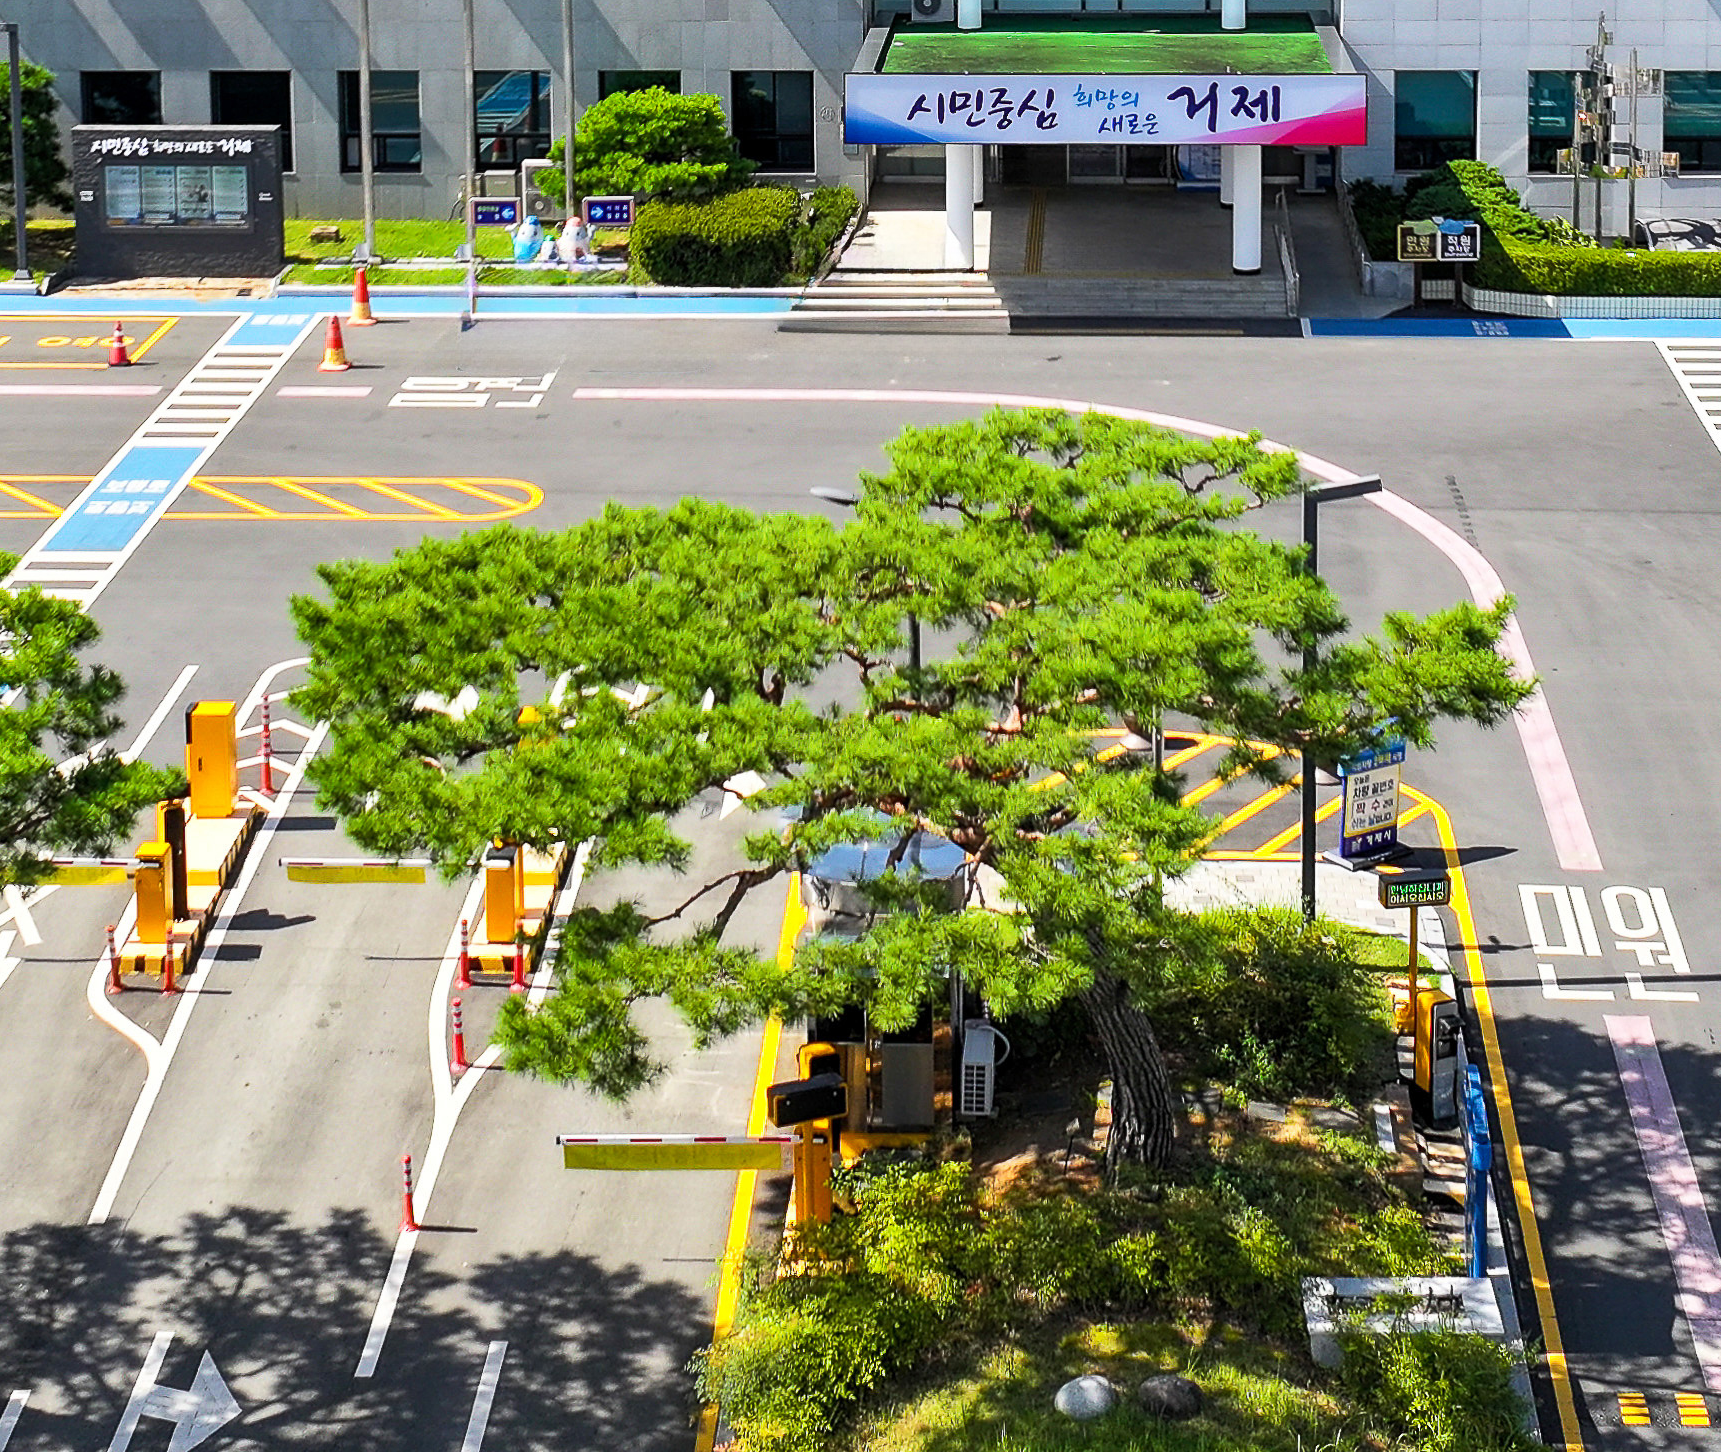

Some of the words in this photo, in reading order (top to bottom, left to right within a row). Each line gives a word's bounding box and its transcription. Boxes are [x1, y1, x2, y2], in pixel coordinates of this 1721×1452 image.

[906, 86, 1059, 130] 시민중심
[1072, 84, 1140, 110] 희망의
[1166, 82, 1282, 134] 거제
[1097, 113, 1161, 136] 새로운
[1518, 883, 1701, 1003] 민원
